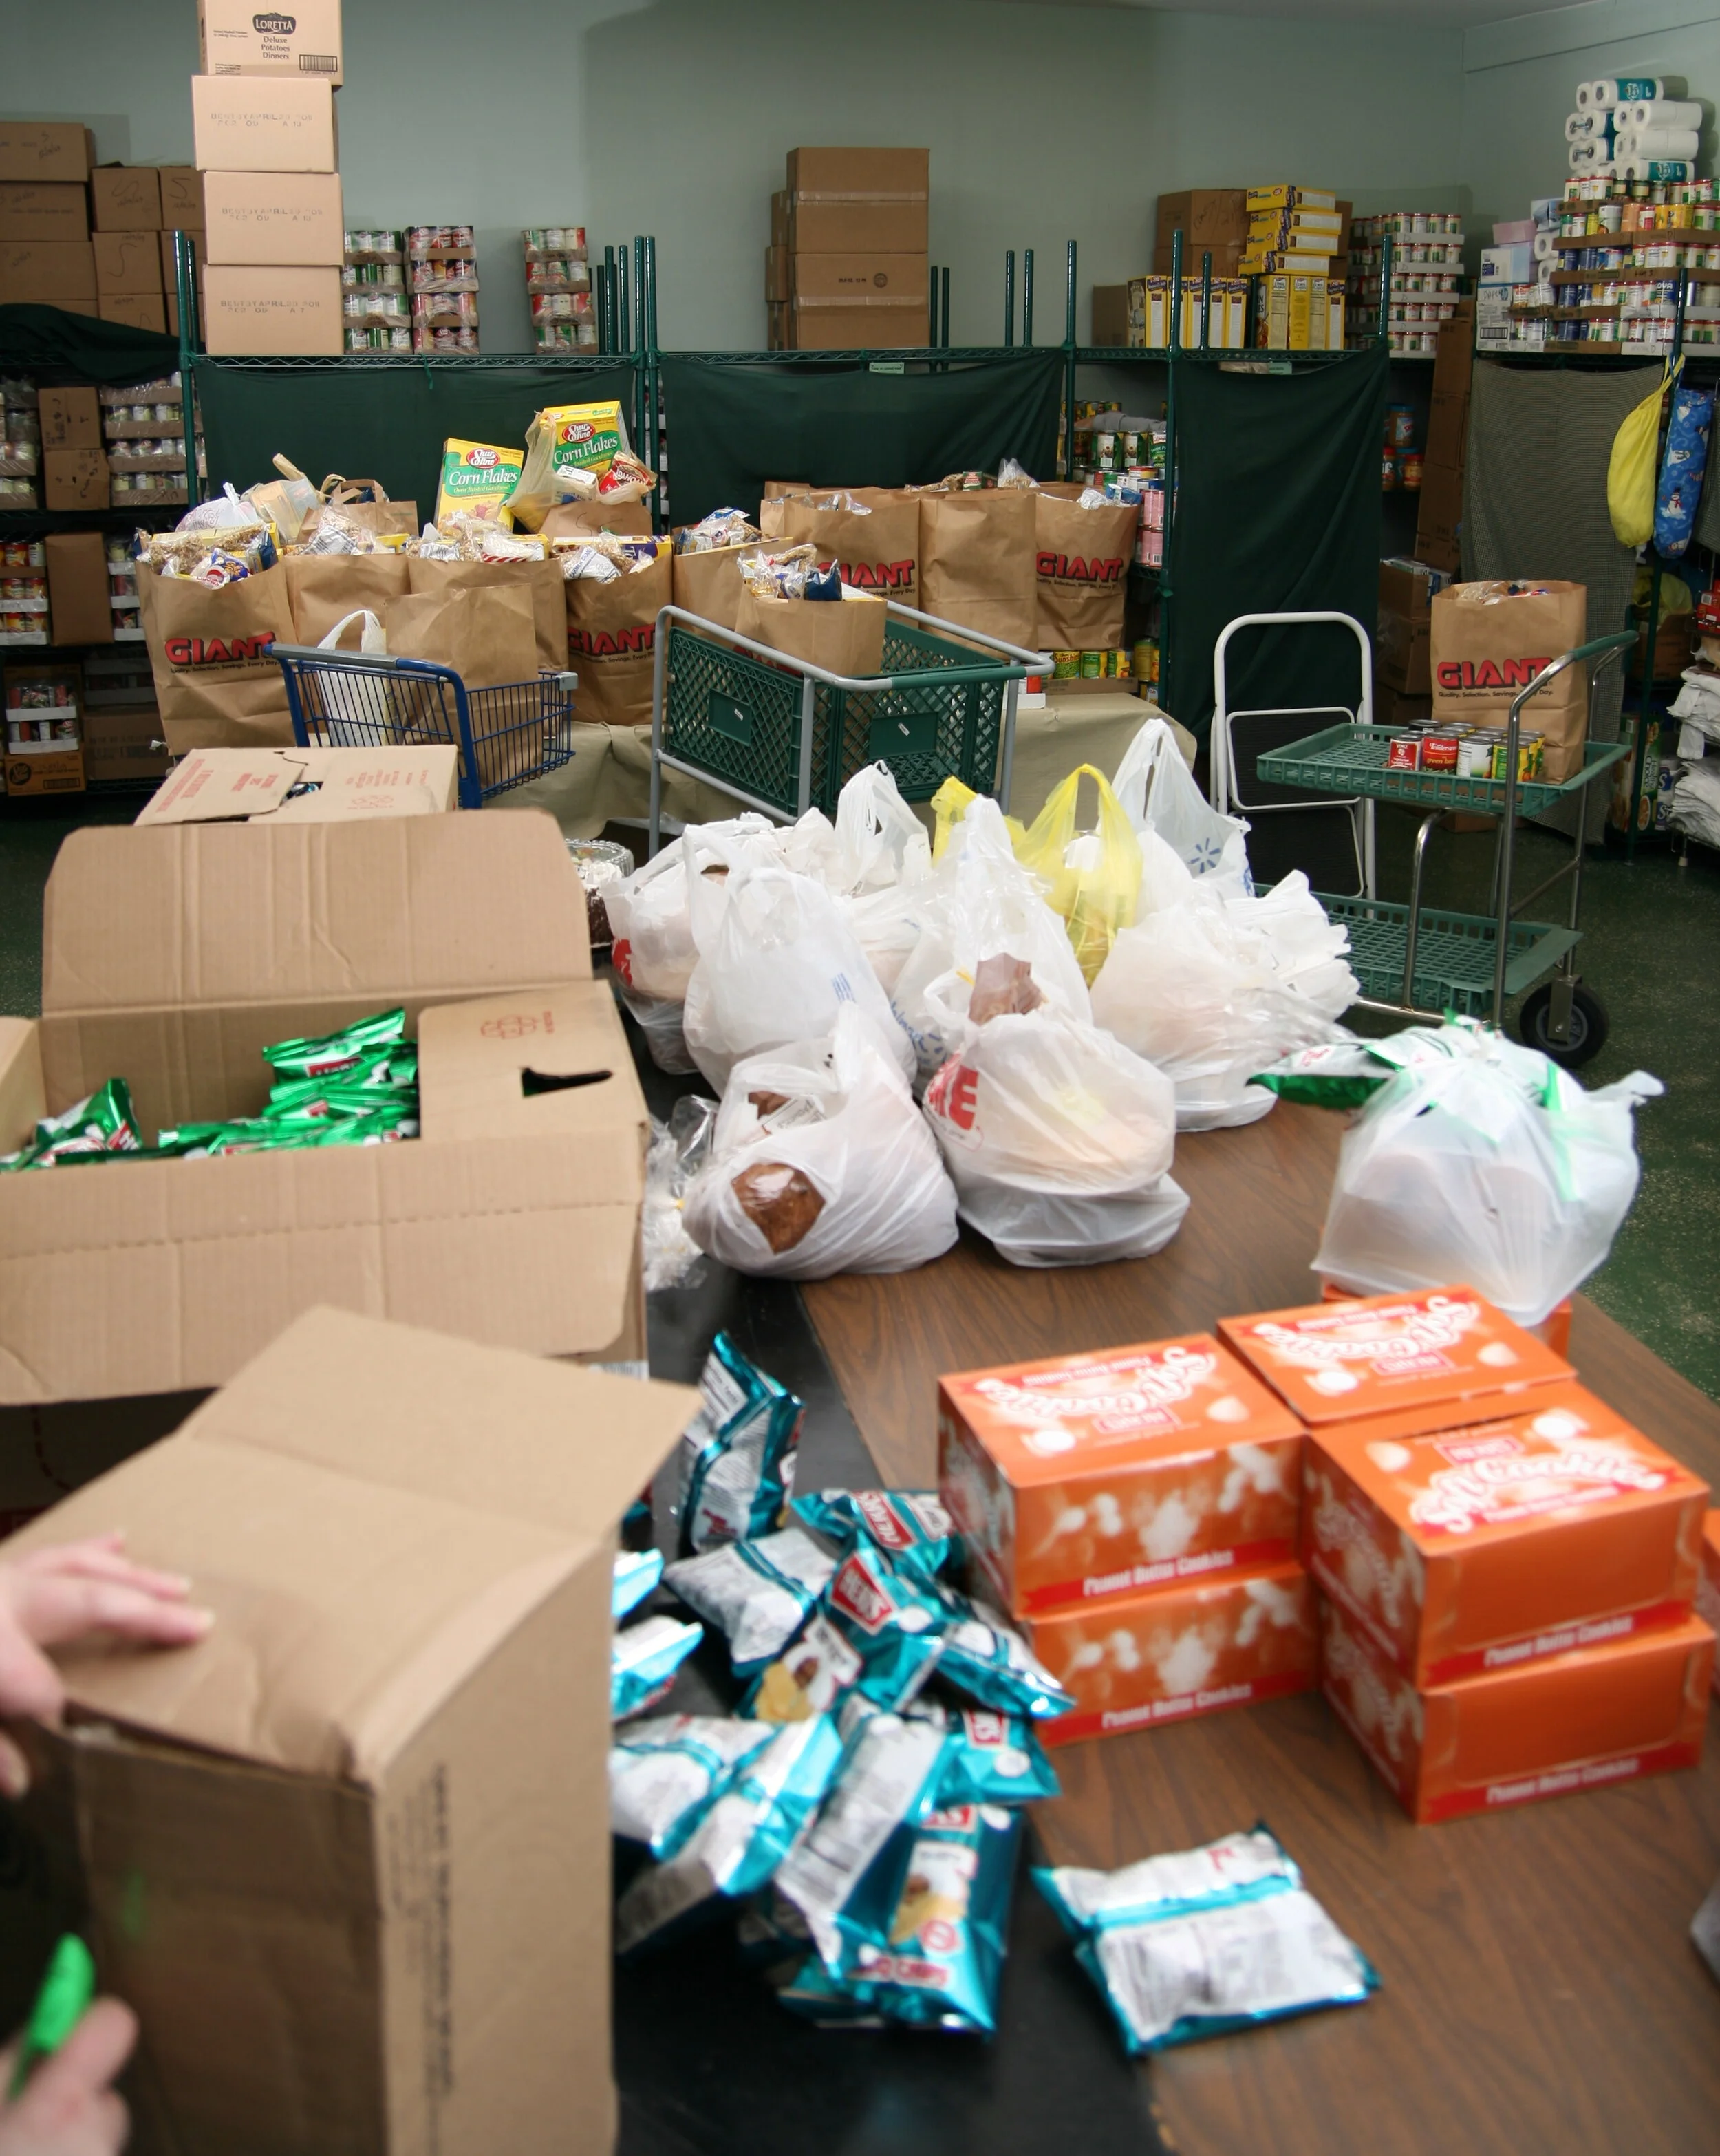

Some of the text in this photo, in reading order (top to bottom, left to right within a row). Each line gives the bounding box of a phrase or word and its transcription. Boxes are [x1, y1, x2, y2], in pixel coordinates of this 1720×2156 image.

[255, 19, 293, 31] LORETTA
[554, 436, 618, 465] Corn Flakes
[449, 468, 517, 486] Corn Flakes
[1036, 551, 1124, 582] GIANT
[164, 631, 277, 666] GIANT
[568, 622, 656, 657] GIANT
[1437, 657, 1555, 690] GIANT
